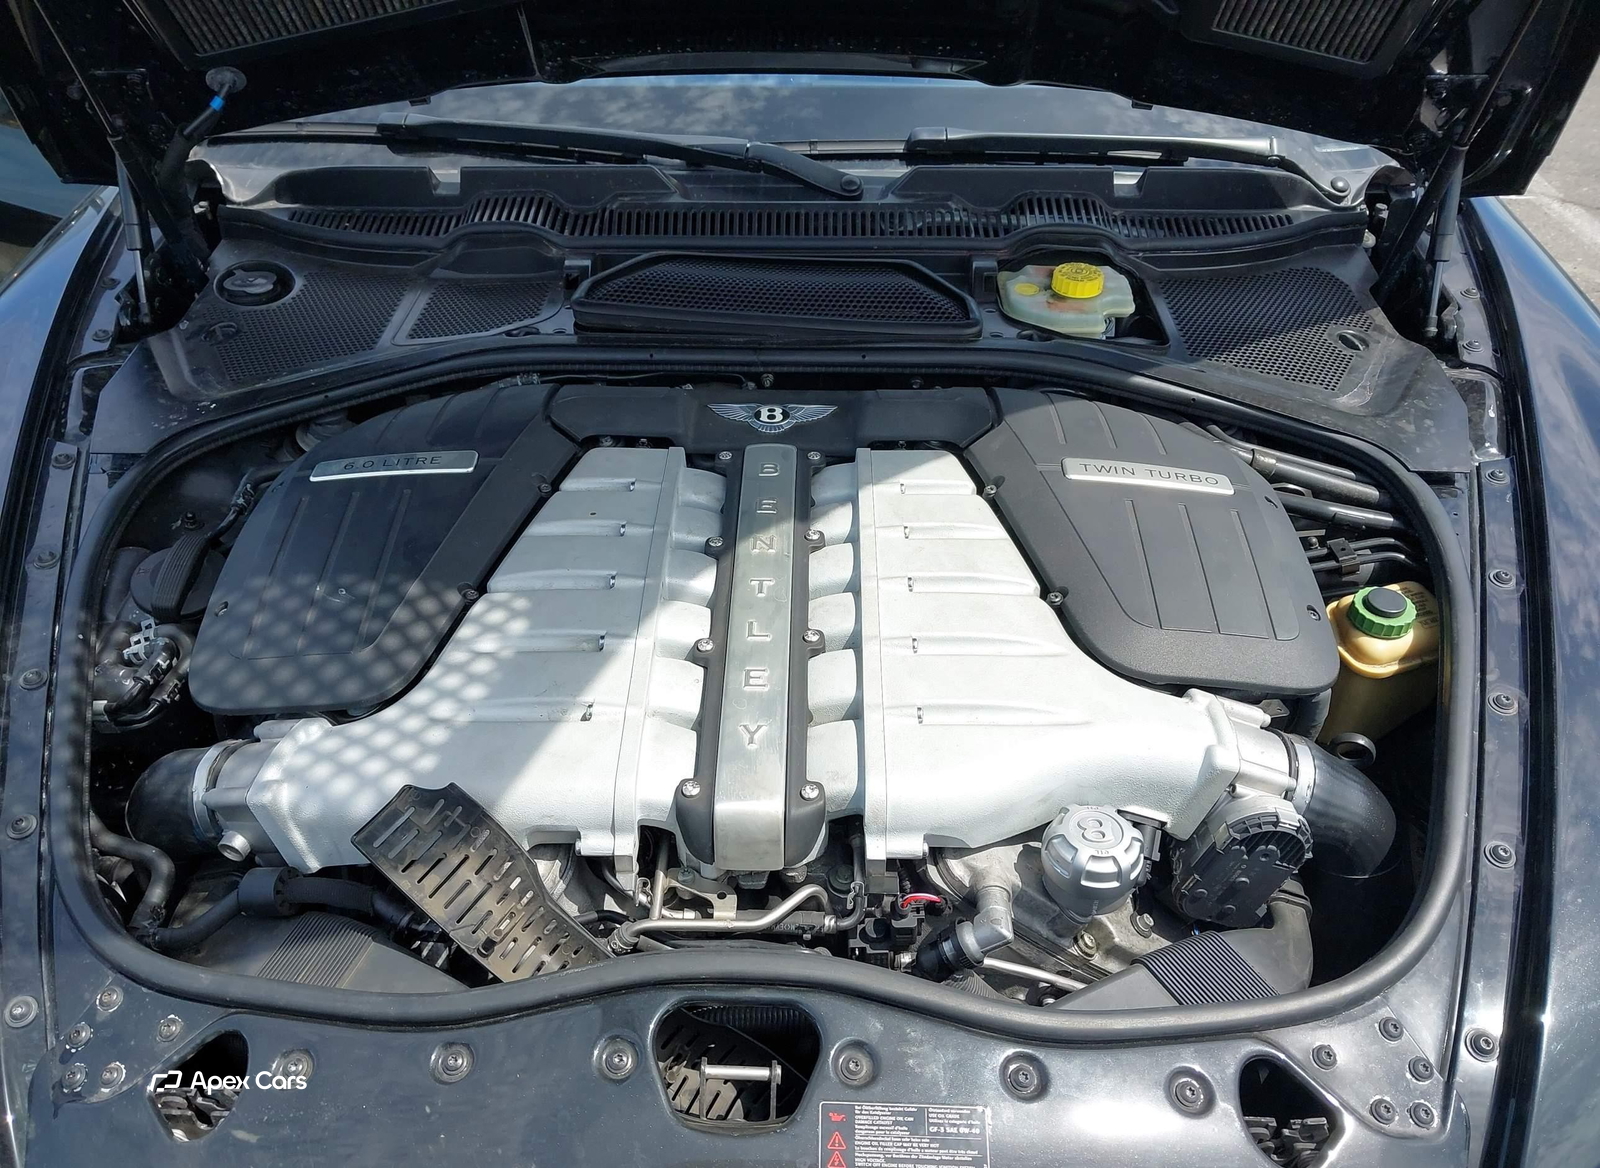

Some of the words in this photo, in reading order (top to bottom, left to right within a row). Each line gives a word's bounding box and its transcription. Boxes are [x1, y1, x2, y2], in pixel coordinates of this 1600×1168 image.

[760, 407, 784, 423] B
[344, 461, 374, 470] 6.0
[382, 456, 442, 467] LITRE
[1079, 463, 1136, 476] TWIN
[1145, 468, 1219, 485] TURBO
[739, 463, 779, 749] BENTLEY
